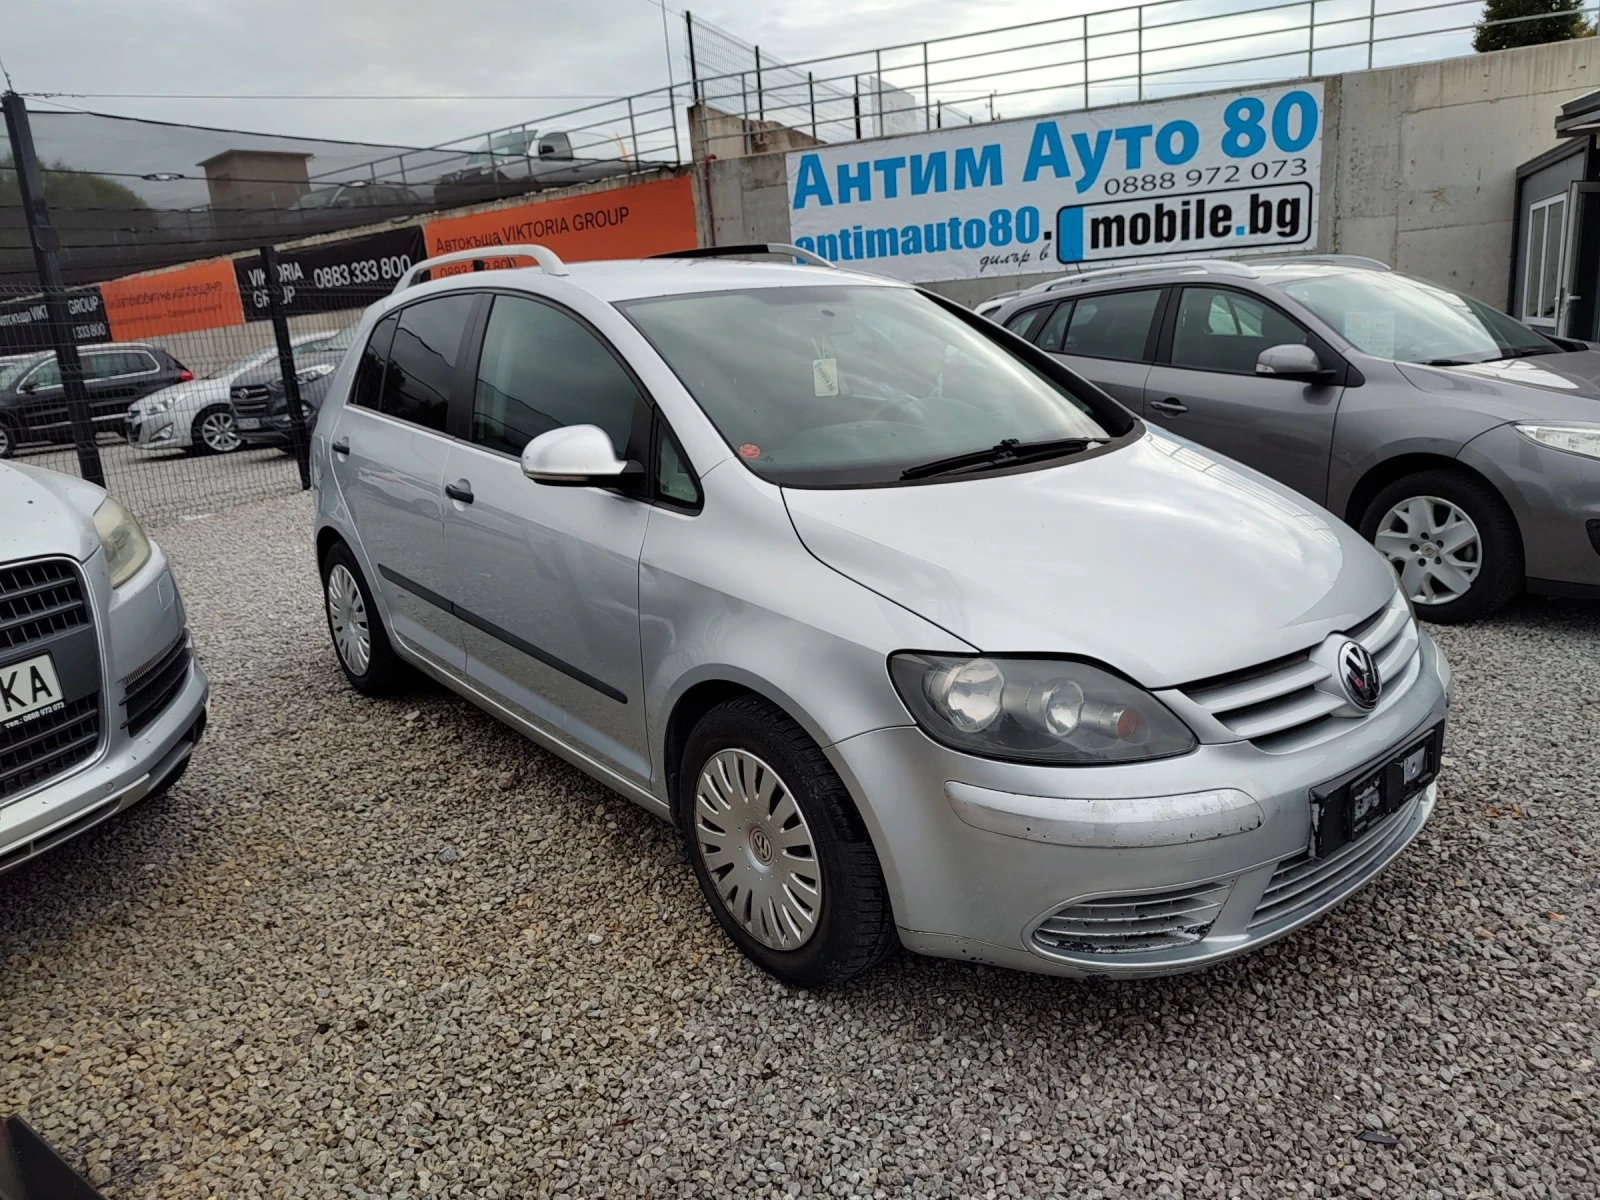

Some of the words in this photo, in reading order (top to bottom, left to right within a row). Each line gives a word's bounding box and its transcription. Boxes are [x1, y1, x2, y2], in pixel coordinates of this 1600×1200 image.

[793, 144, 1003, 210] Антим
[1022, 119, 1199, 194] Ауто
[1221, 90, 1318, 158] 80
[1104, 172, 1175, 195] 0888
[1186, 165, 1240, 187] 972
[1250, 158, 1307, 180] 073
[436, 231, 501, 253] Автокъща
[502, 217, 570, 243] VIKTORIA
[573, 206, 629, 231] GROUP
[1090, 194, 1301, 249] mobile.bg
[248, 262, 304, 287] VIKRIA
[313, 264, 350, 289] 0883
[350, 259, 379, 283] 333
[380, 254, 412, 279] 800
[980, 249, 1030, 273] дилър
[67, 295, 99, 315] GROUP
[90, 322, 106, 337] 800
[0, 665, 53, 713] KA
[22, 711, 40, 722] 0888
[40, 706, 53, 716] 972
[52, 701, 65, 711] 073
